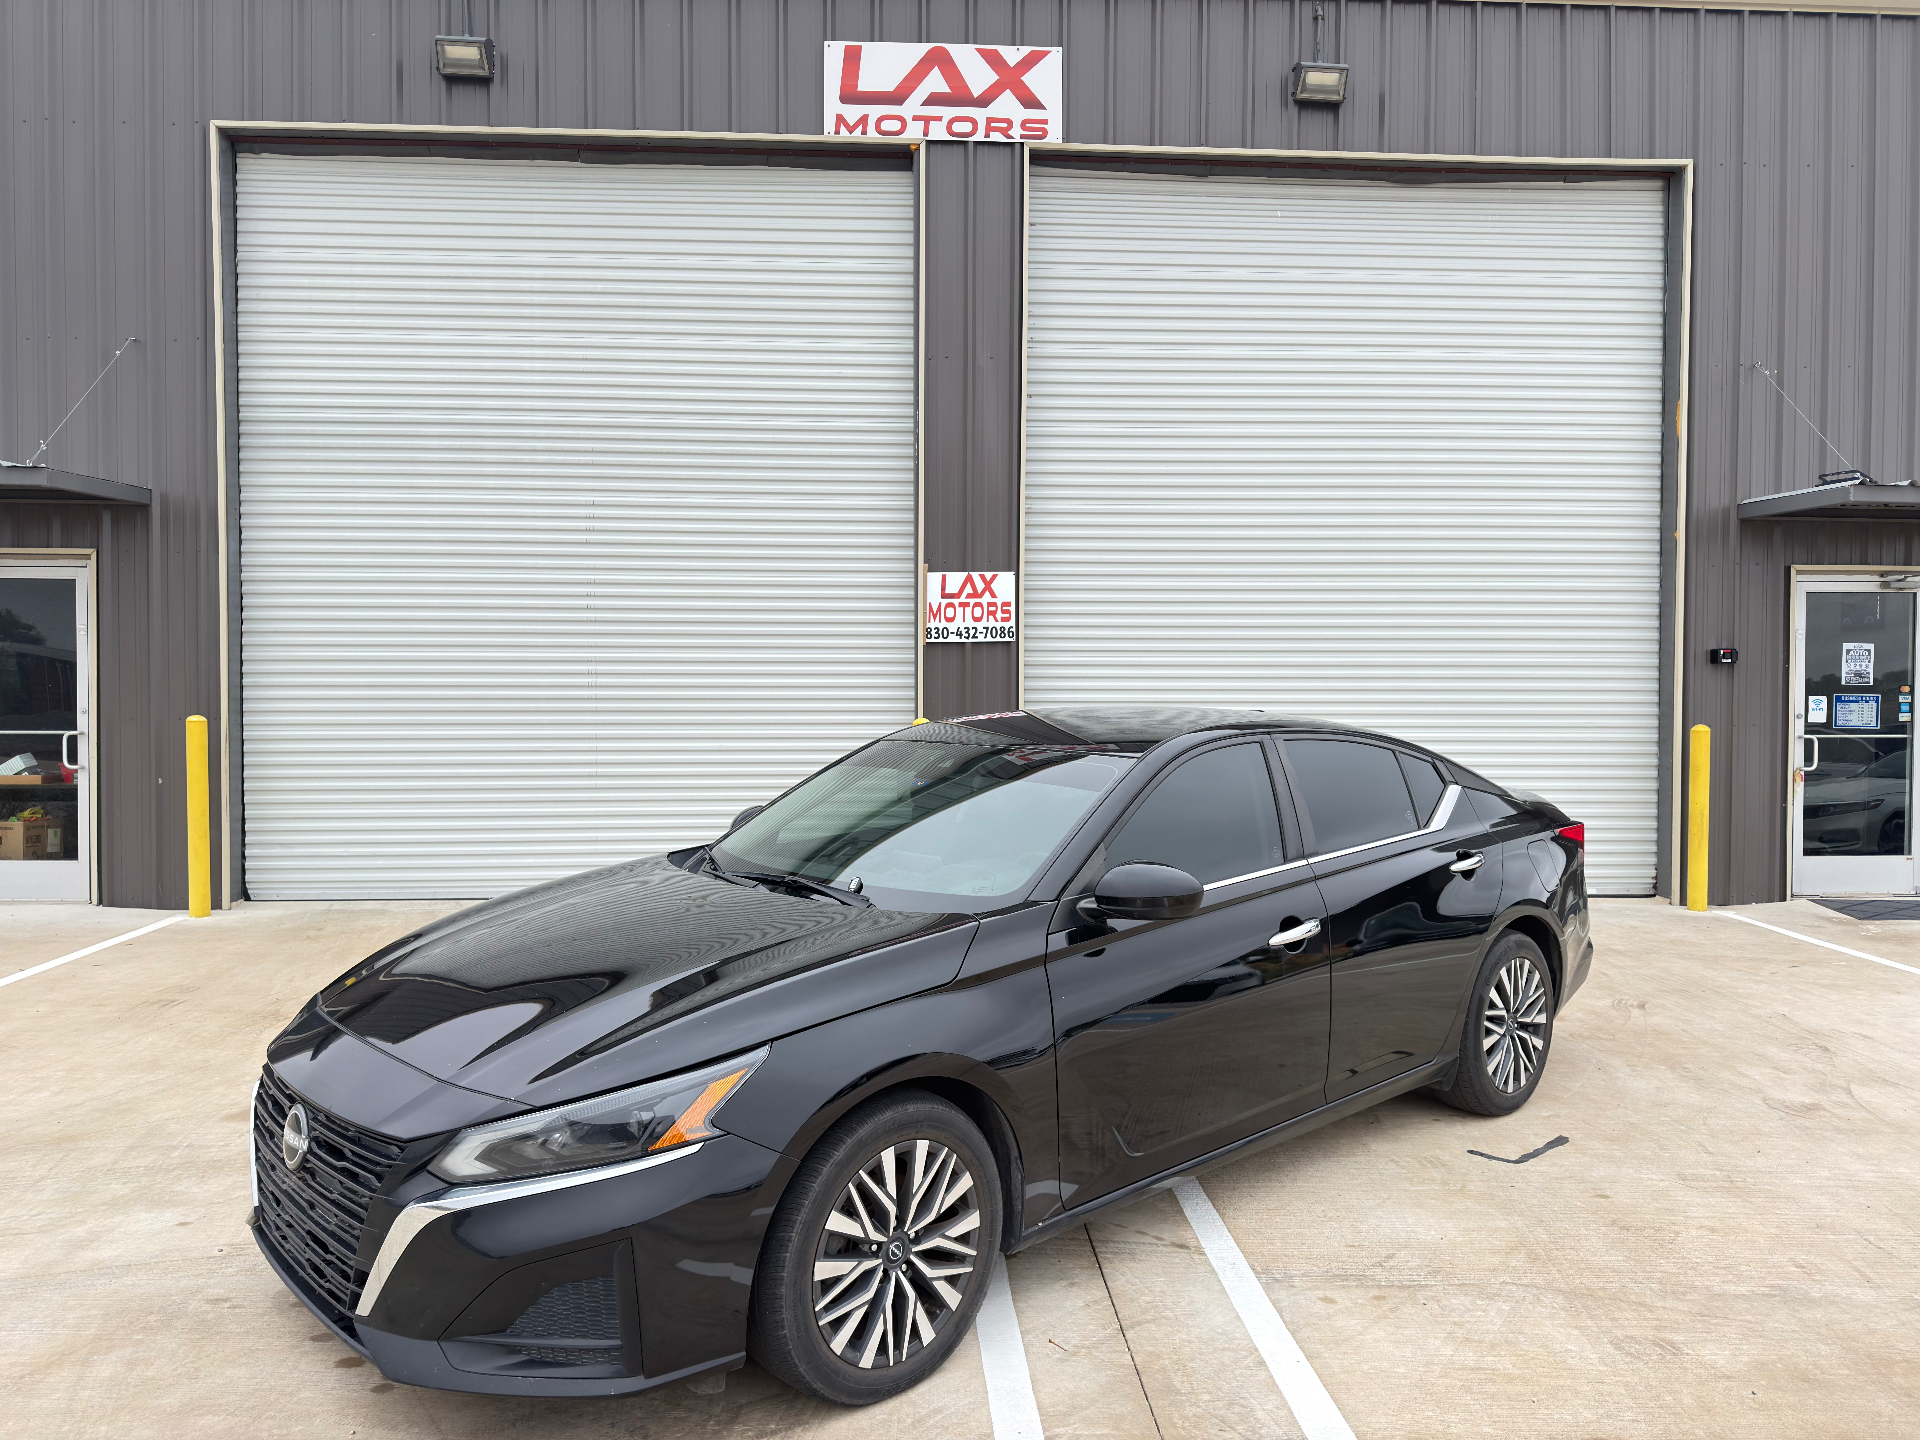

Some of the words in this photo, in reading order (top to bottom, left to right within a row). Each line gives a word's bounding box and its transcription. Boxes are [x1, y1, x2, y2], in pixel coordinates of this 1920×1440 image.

[839, 45, 1053, 110] LAX
[834, 113, 1049, 140] MOTORS
[941, 574, 999, 599] LAX
[928, 601, 1012, 623] MOTORS
[926, 626, 1015, 640] 830-432-7086
[286, 1130, 308, 1150] SSAN
